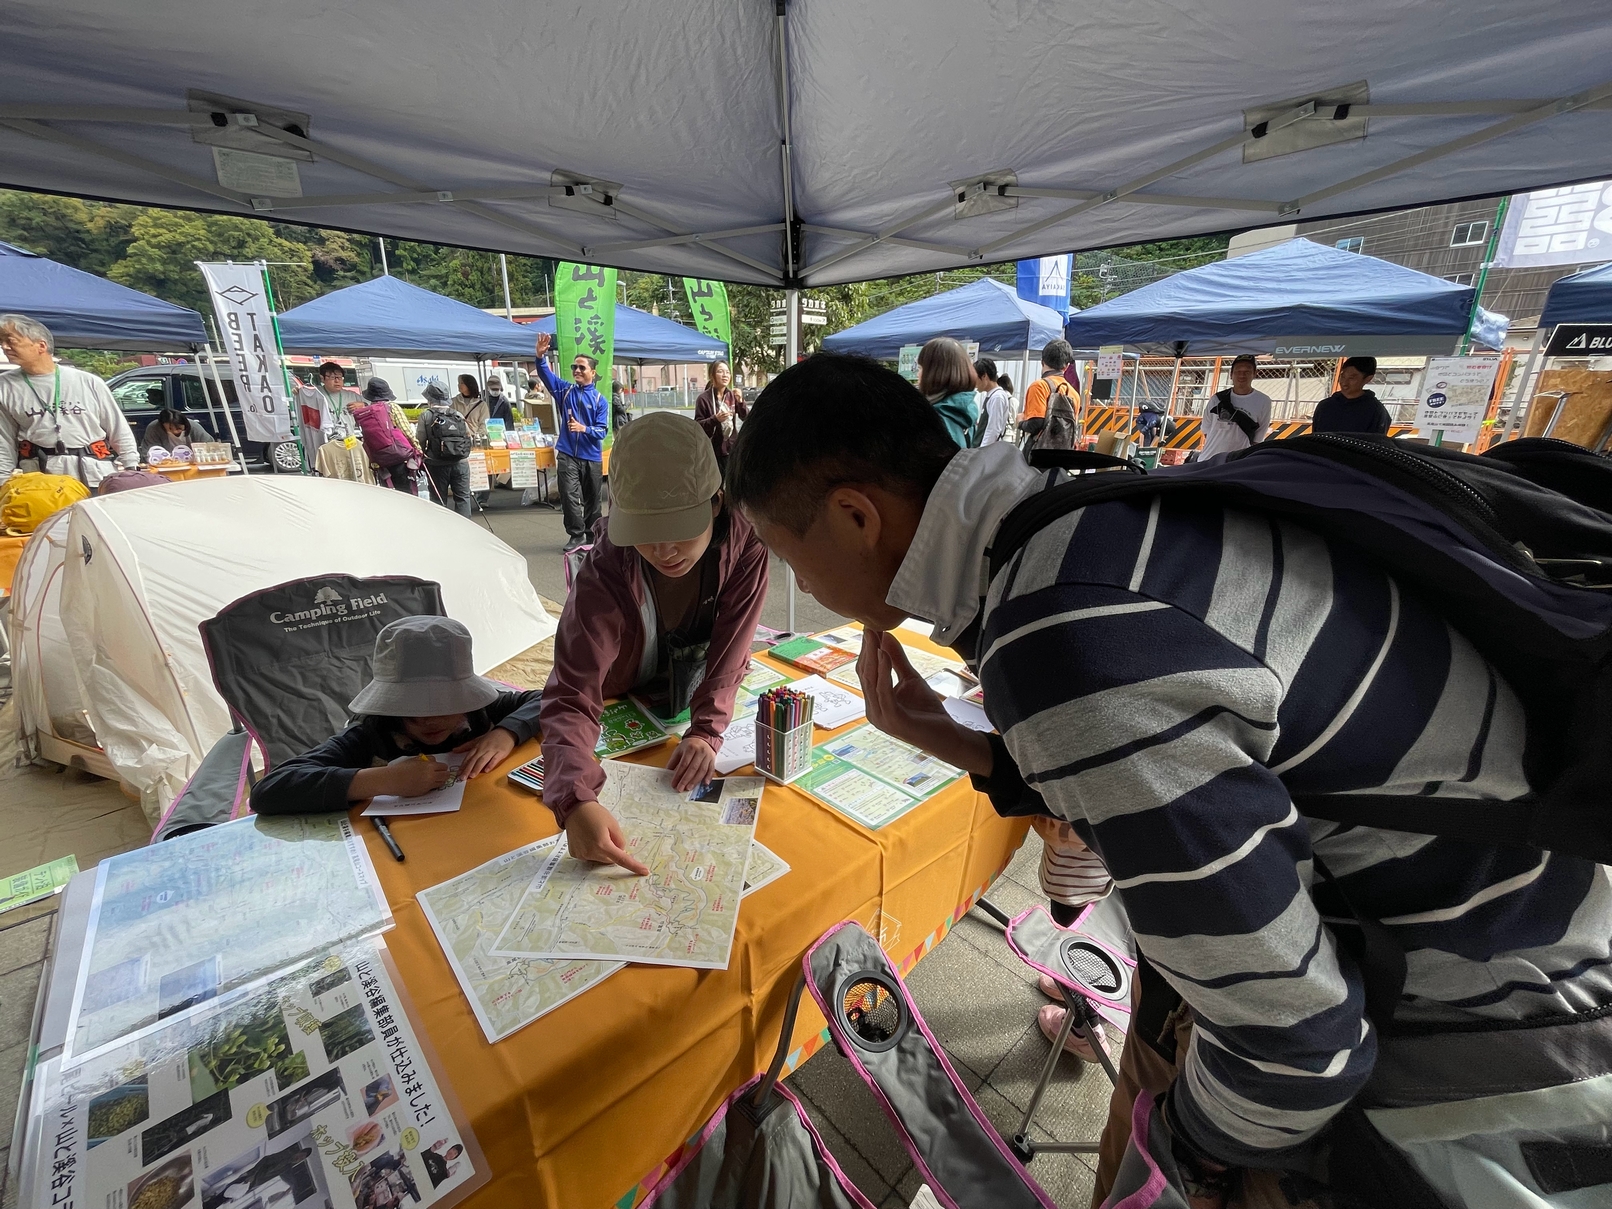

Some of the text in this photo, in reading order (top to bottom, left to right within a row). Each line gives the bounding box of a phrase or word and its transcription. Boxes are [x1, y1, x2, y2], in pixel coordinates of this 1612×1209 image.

[572, 264, 606, 385] 山と溪
[1275, 344, 1346, 354] EVERNEW
[269, 592, 388, 624] Camping Field
[299, 619, 333, 630] Technique
[342, 613, 368, 622] Outdoor
[369, 609, 381, 617] Life
